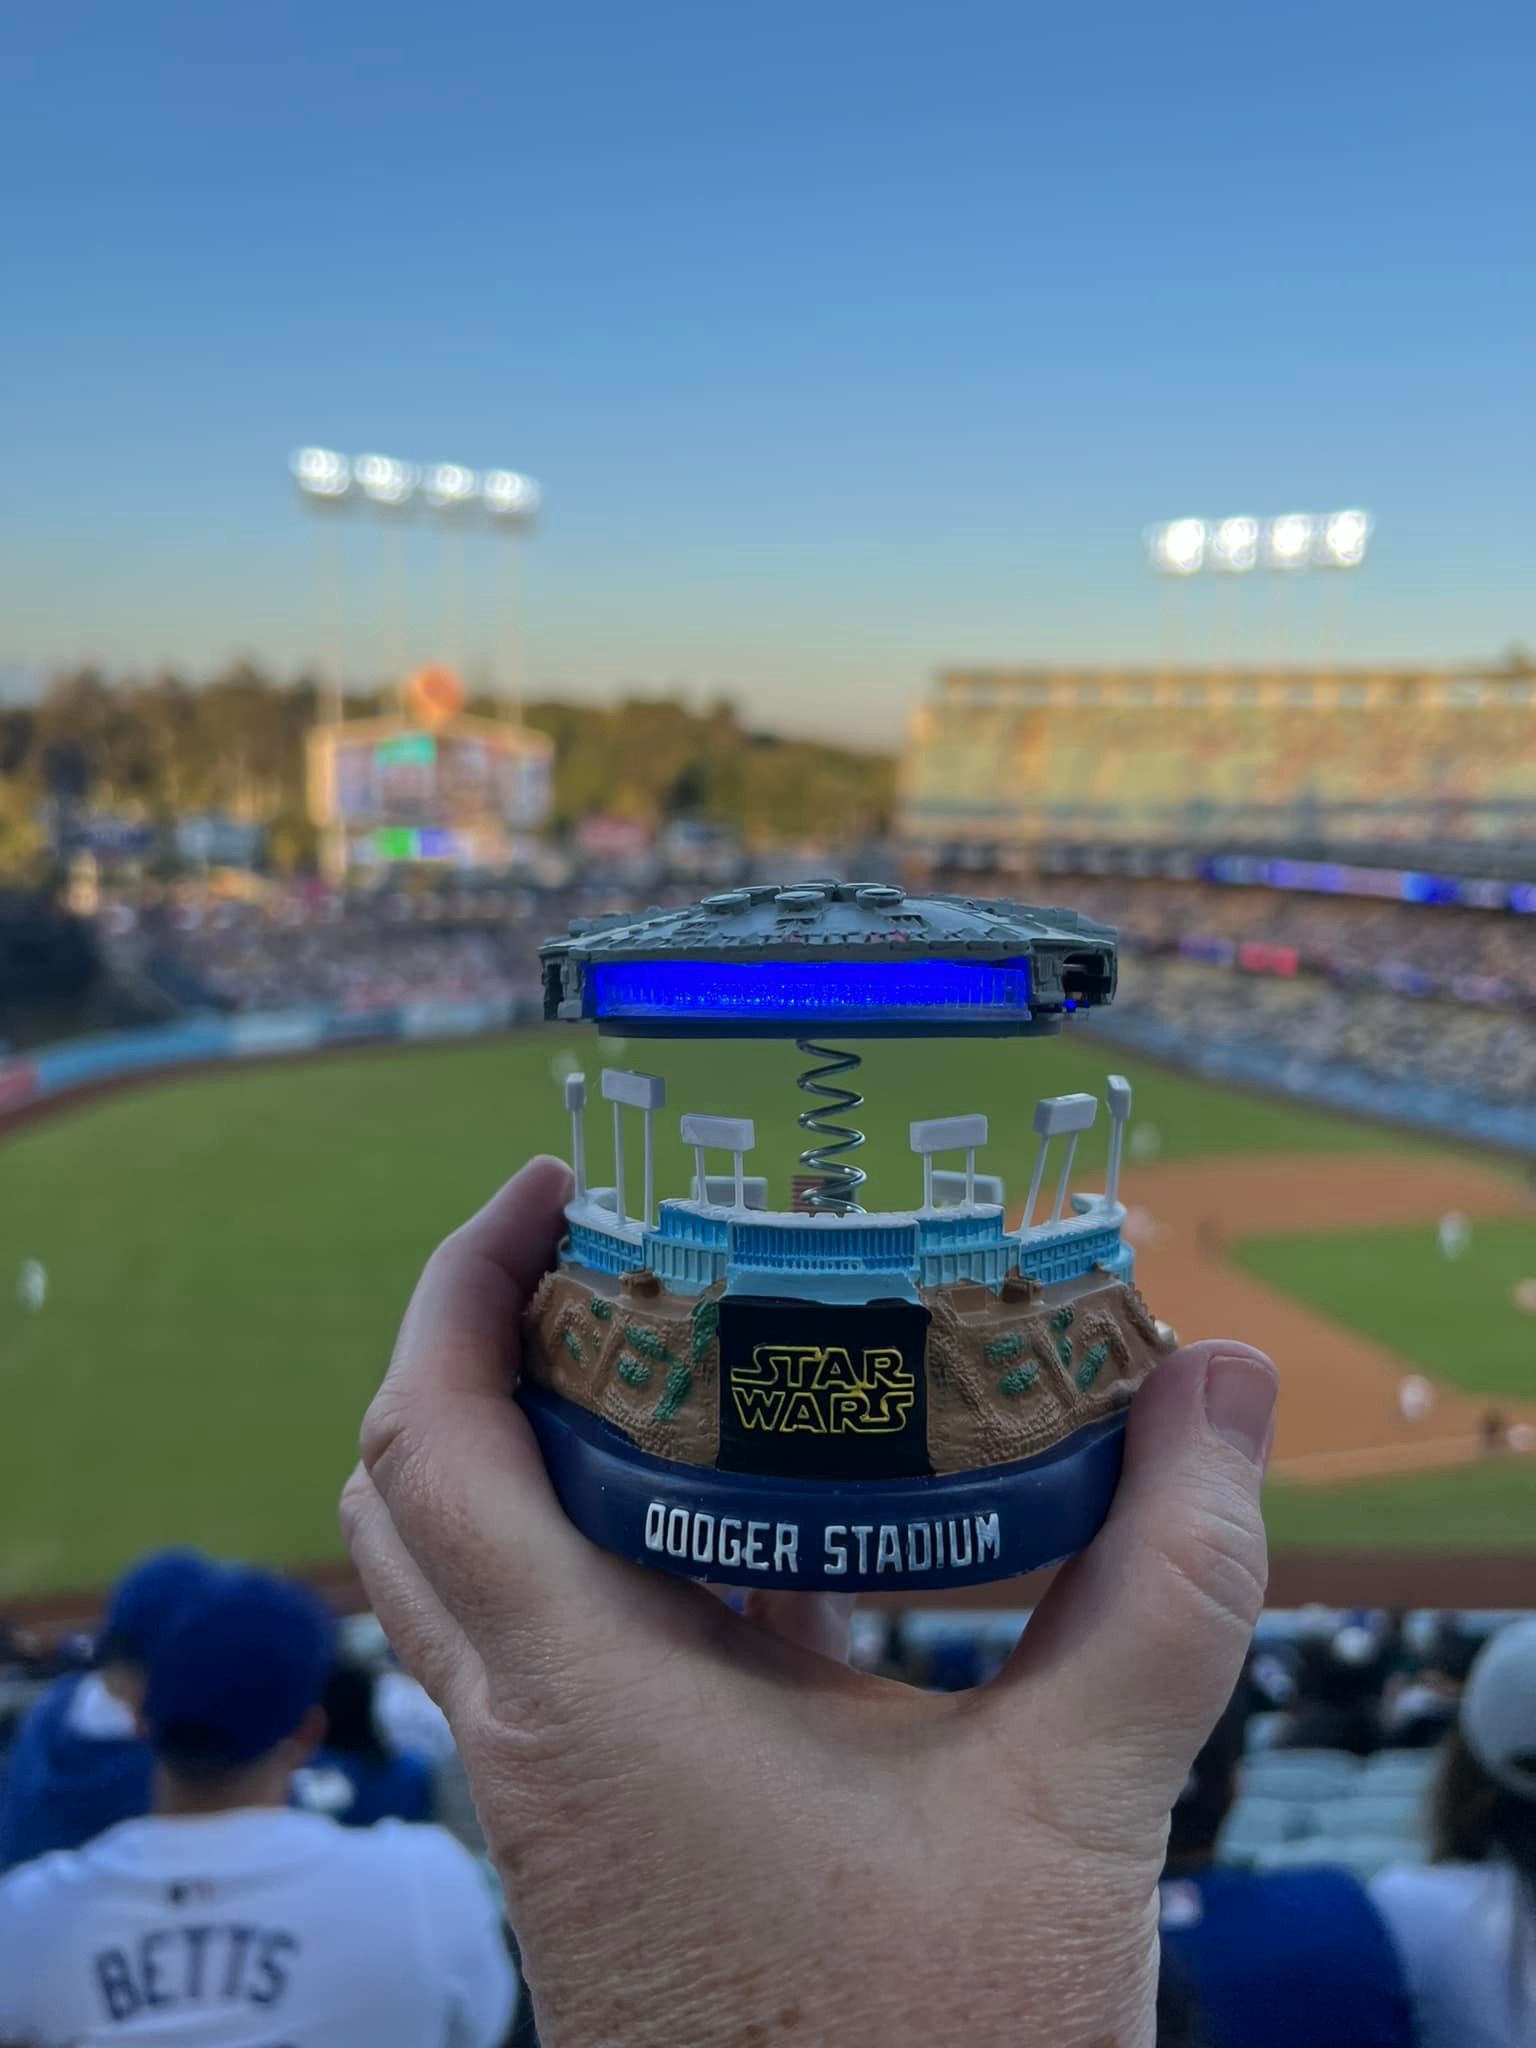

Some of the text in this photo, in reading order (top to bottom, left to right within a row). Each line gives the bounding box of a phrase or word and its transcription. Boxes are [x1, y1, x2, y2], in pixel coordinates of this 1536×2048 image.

[731, 1345, 915, 1390] STAR
[731, 1387, 915, 1433] WARS
[645, 1502, 1000, 1575] DODGER STADIUM
[96, 1925, 295, 2022] BETTS
